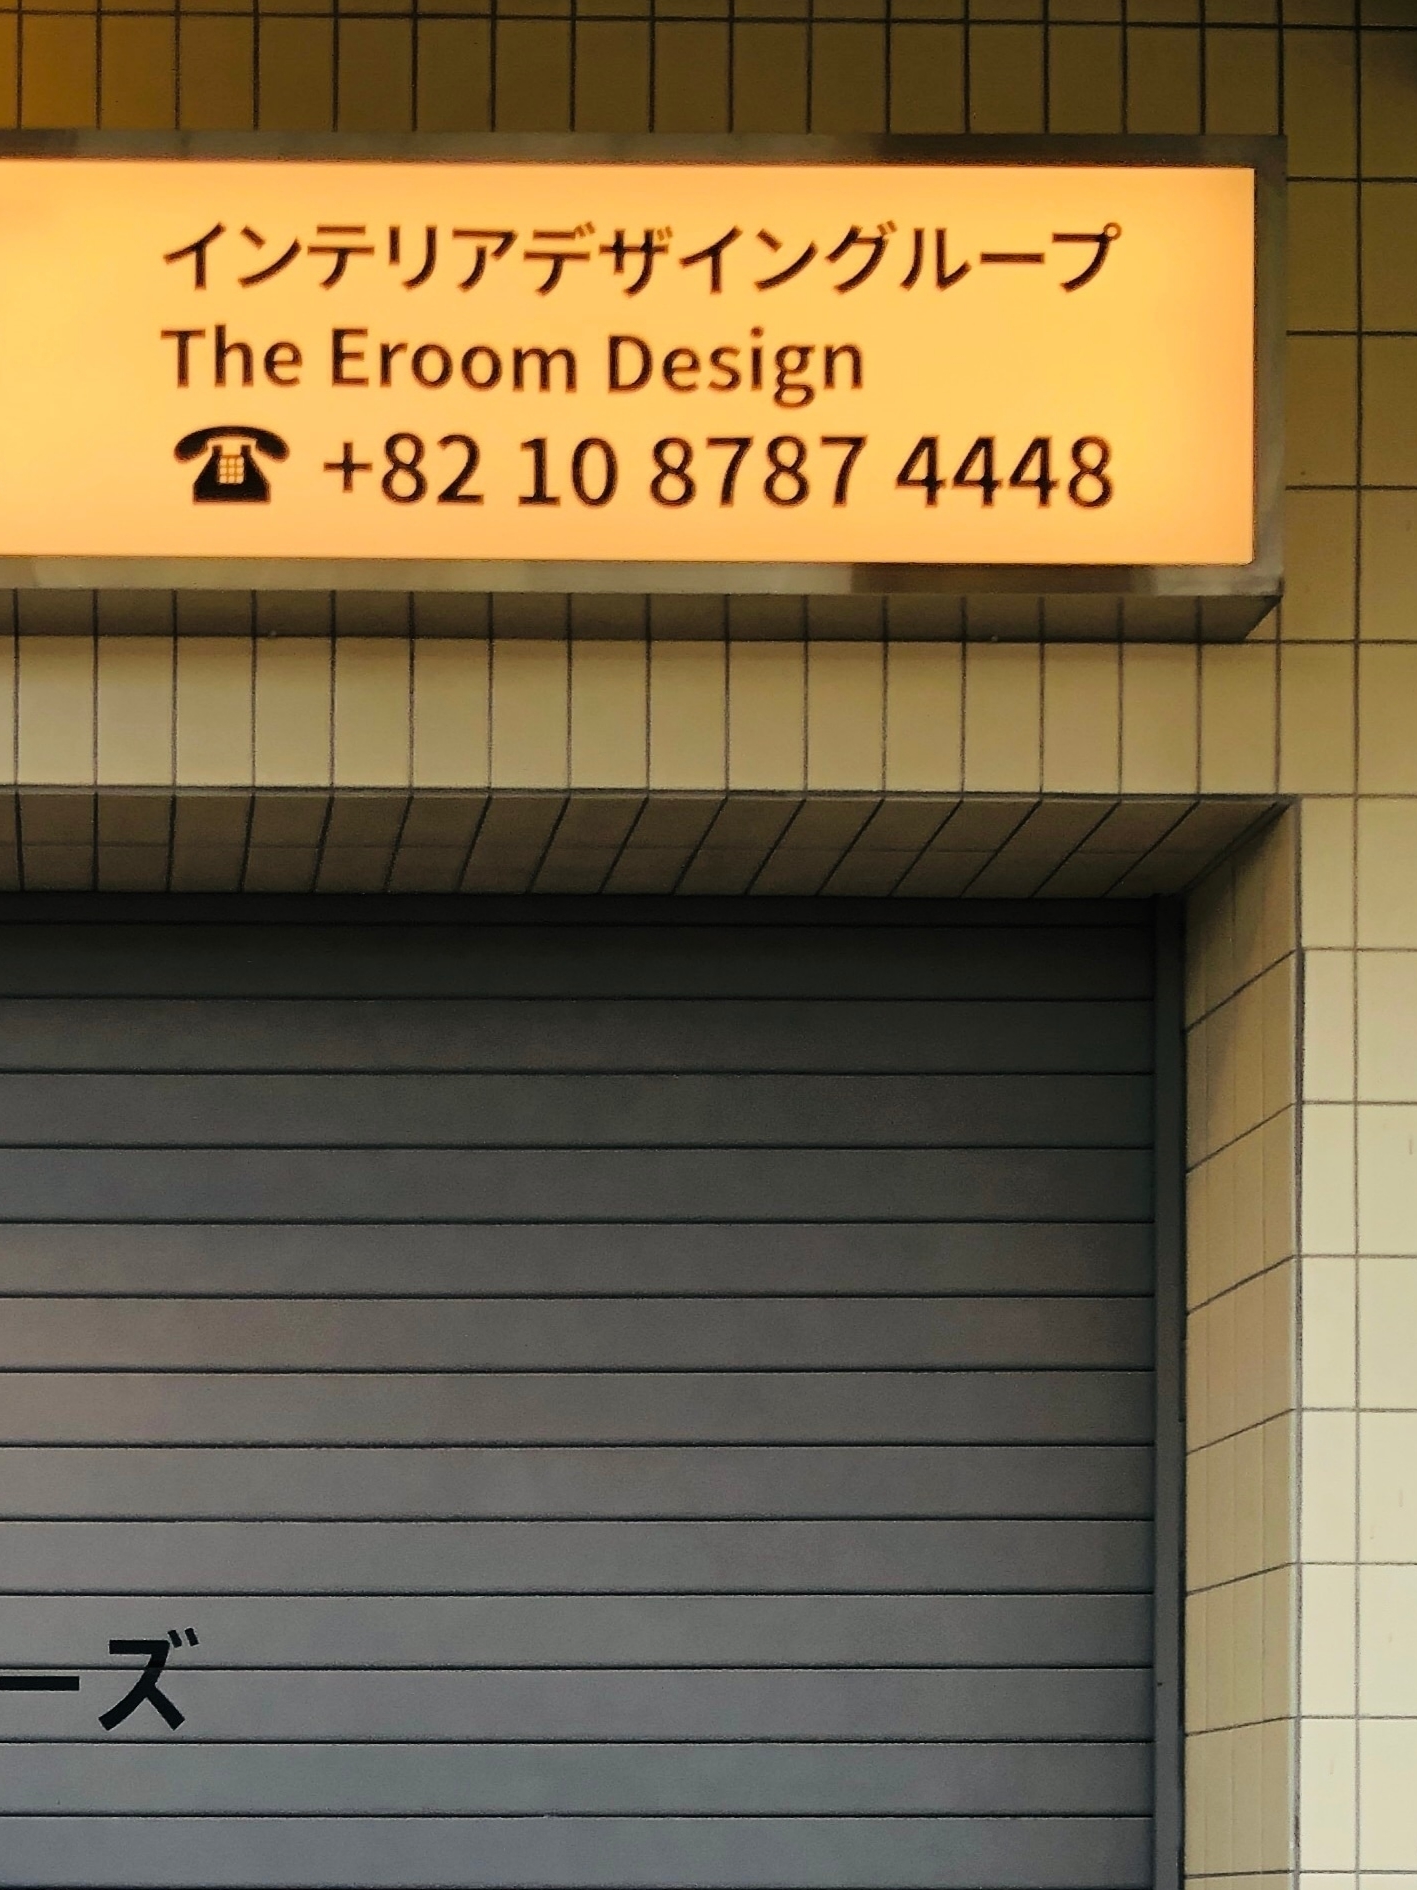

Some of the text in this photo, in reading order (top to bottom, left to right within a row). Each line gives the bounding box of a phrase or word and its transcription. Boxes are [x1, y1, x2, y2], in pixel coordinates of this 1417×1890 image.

[164, 221, 1121, 296] インテリアデザイングループ
[160, 324, 862, 408] The Eroom Design
[323, 432, 1113, 509] +82 10 8787 4448
